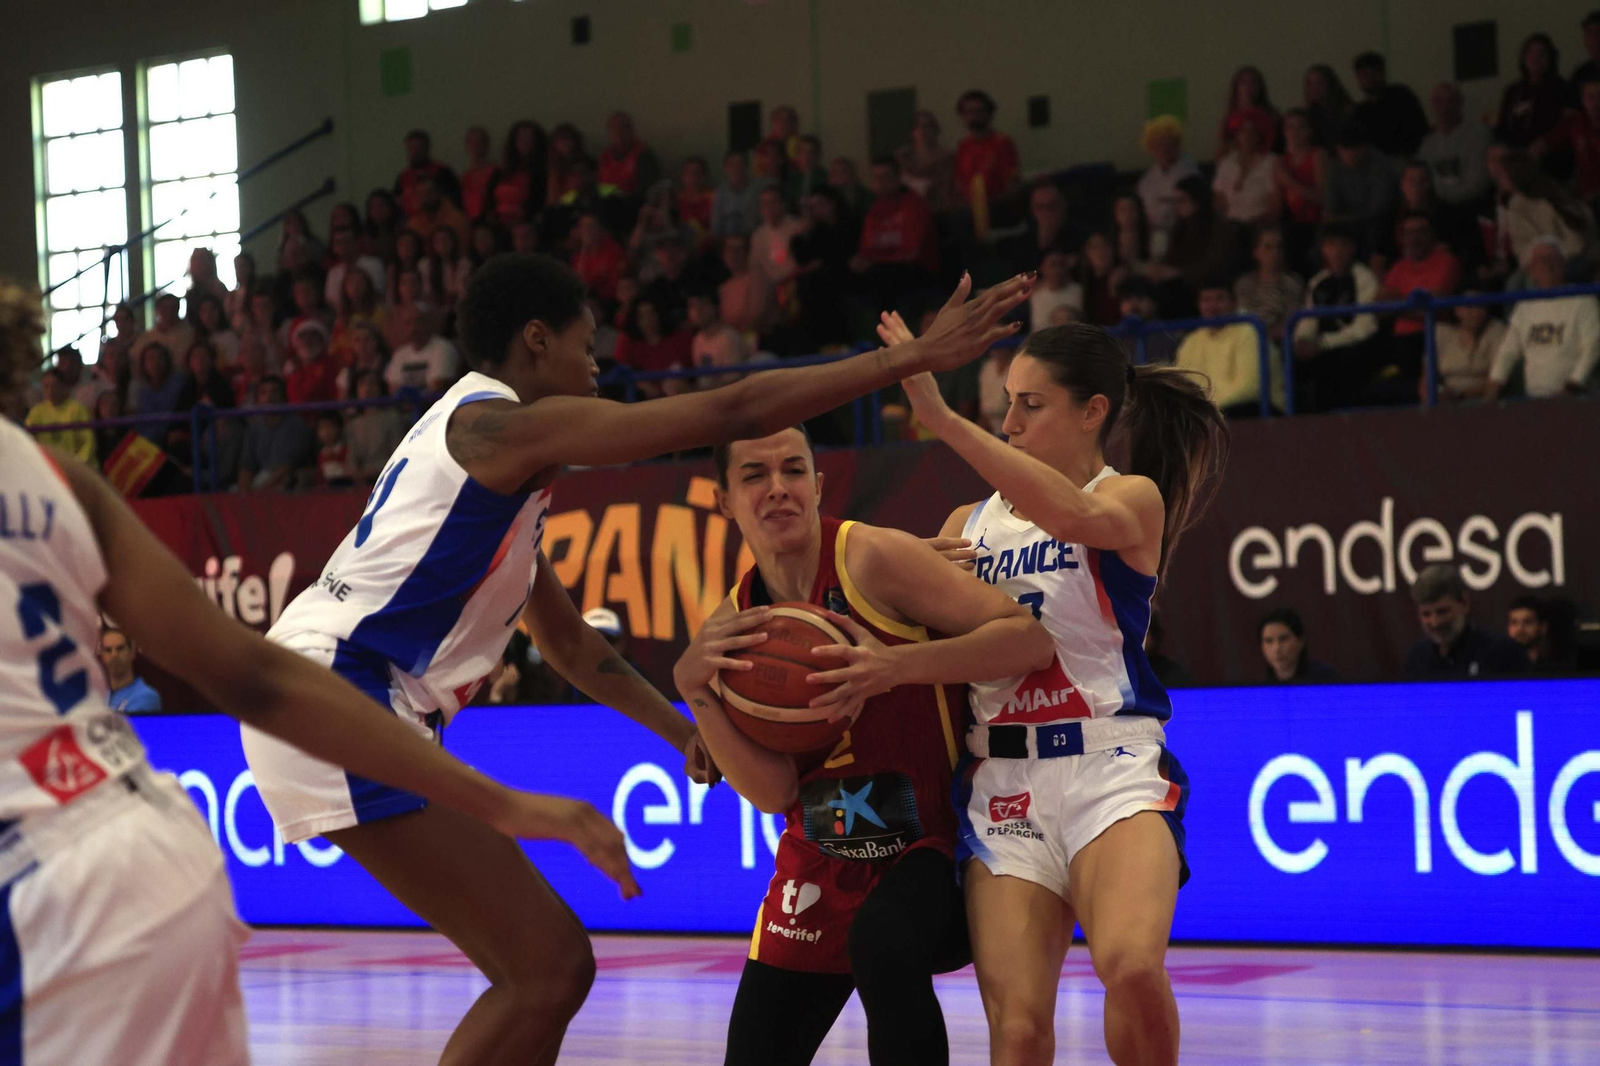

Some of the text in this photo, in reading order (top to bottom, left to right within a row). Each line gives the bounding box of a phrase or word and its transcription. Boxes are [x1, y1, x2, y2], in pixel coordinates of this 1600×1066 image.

[521, 476, 755, 641] PAÑ
[966, 537, 1079, 585] RANCE
[1228, 497, 1565, 598] endesa
[195, 551, 296, 628] ife!
[987, 827, 1044, 841] D'EPARGNE
